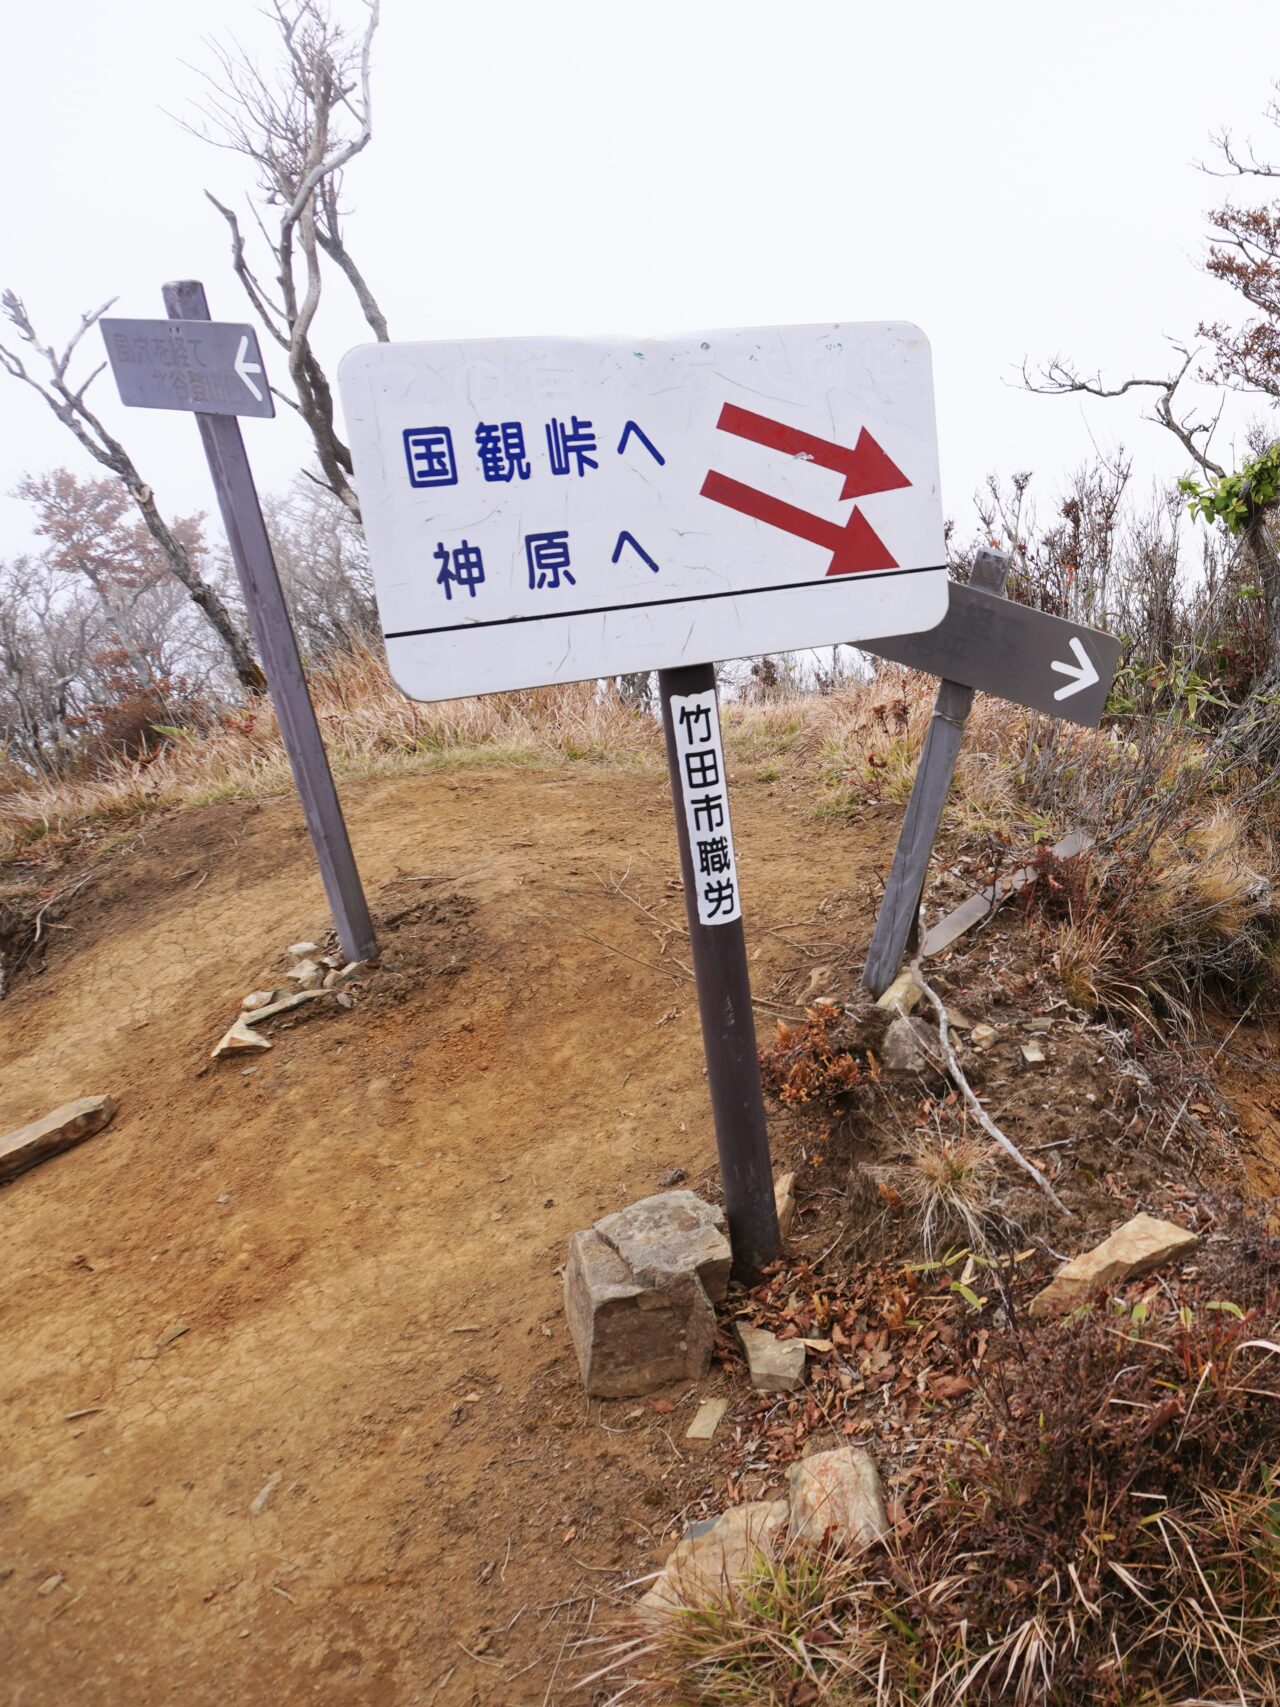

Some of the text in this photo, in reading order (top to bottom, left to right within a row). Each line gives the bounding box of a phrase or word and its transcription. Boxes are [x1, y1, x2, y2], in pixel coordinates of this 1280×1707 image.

[402, 415, 666, 489] 国観峠へ
[433, 530, 659, 600] 神原へ
[679, 703, 735, 919] 竹田市職労
